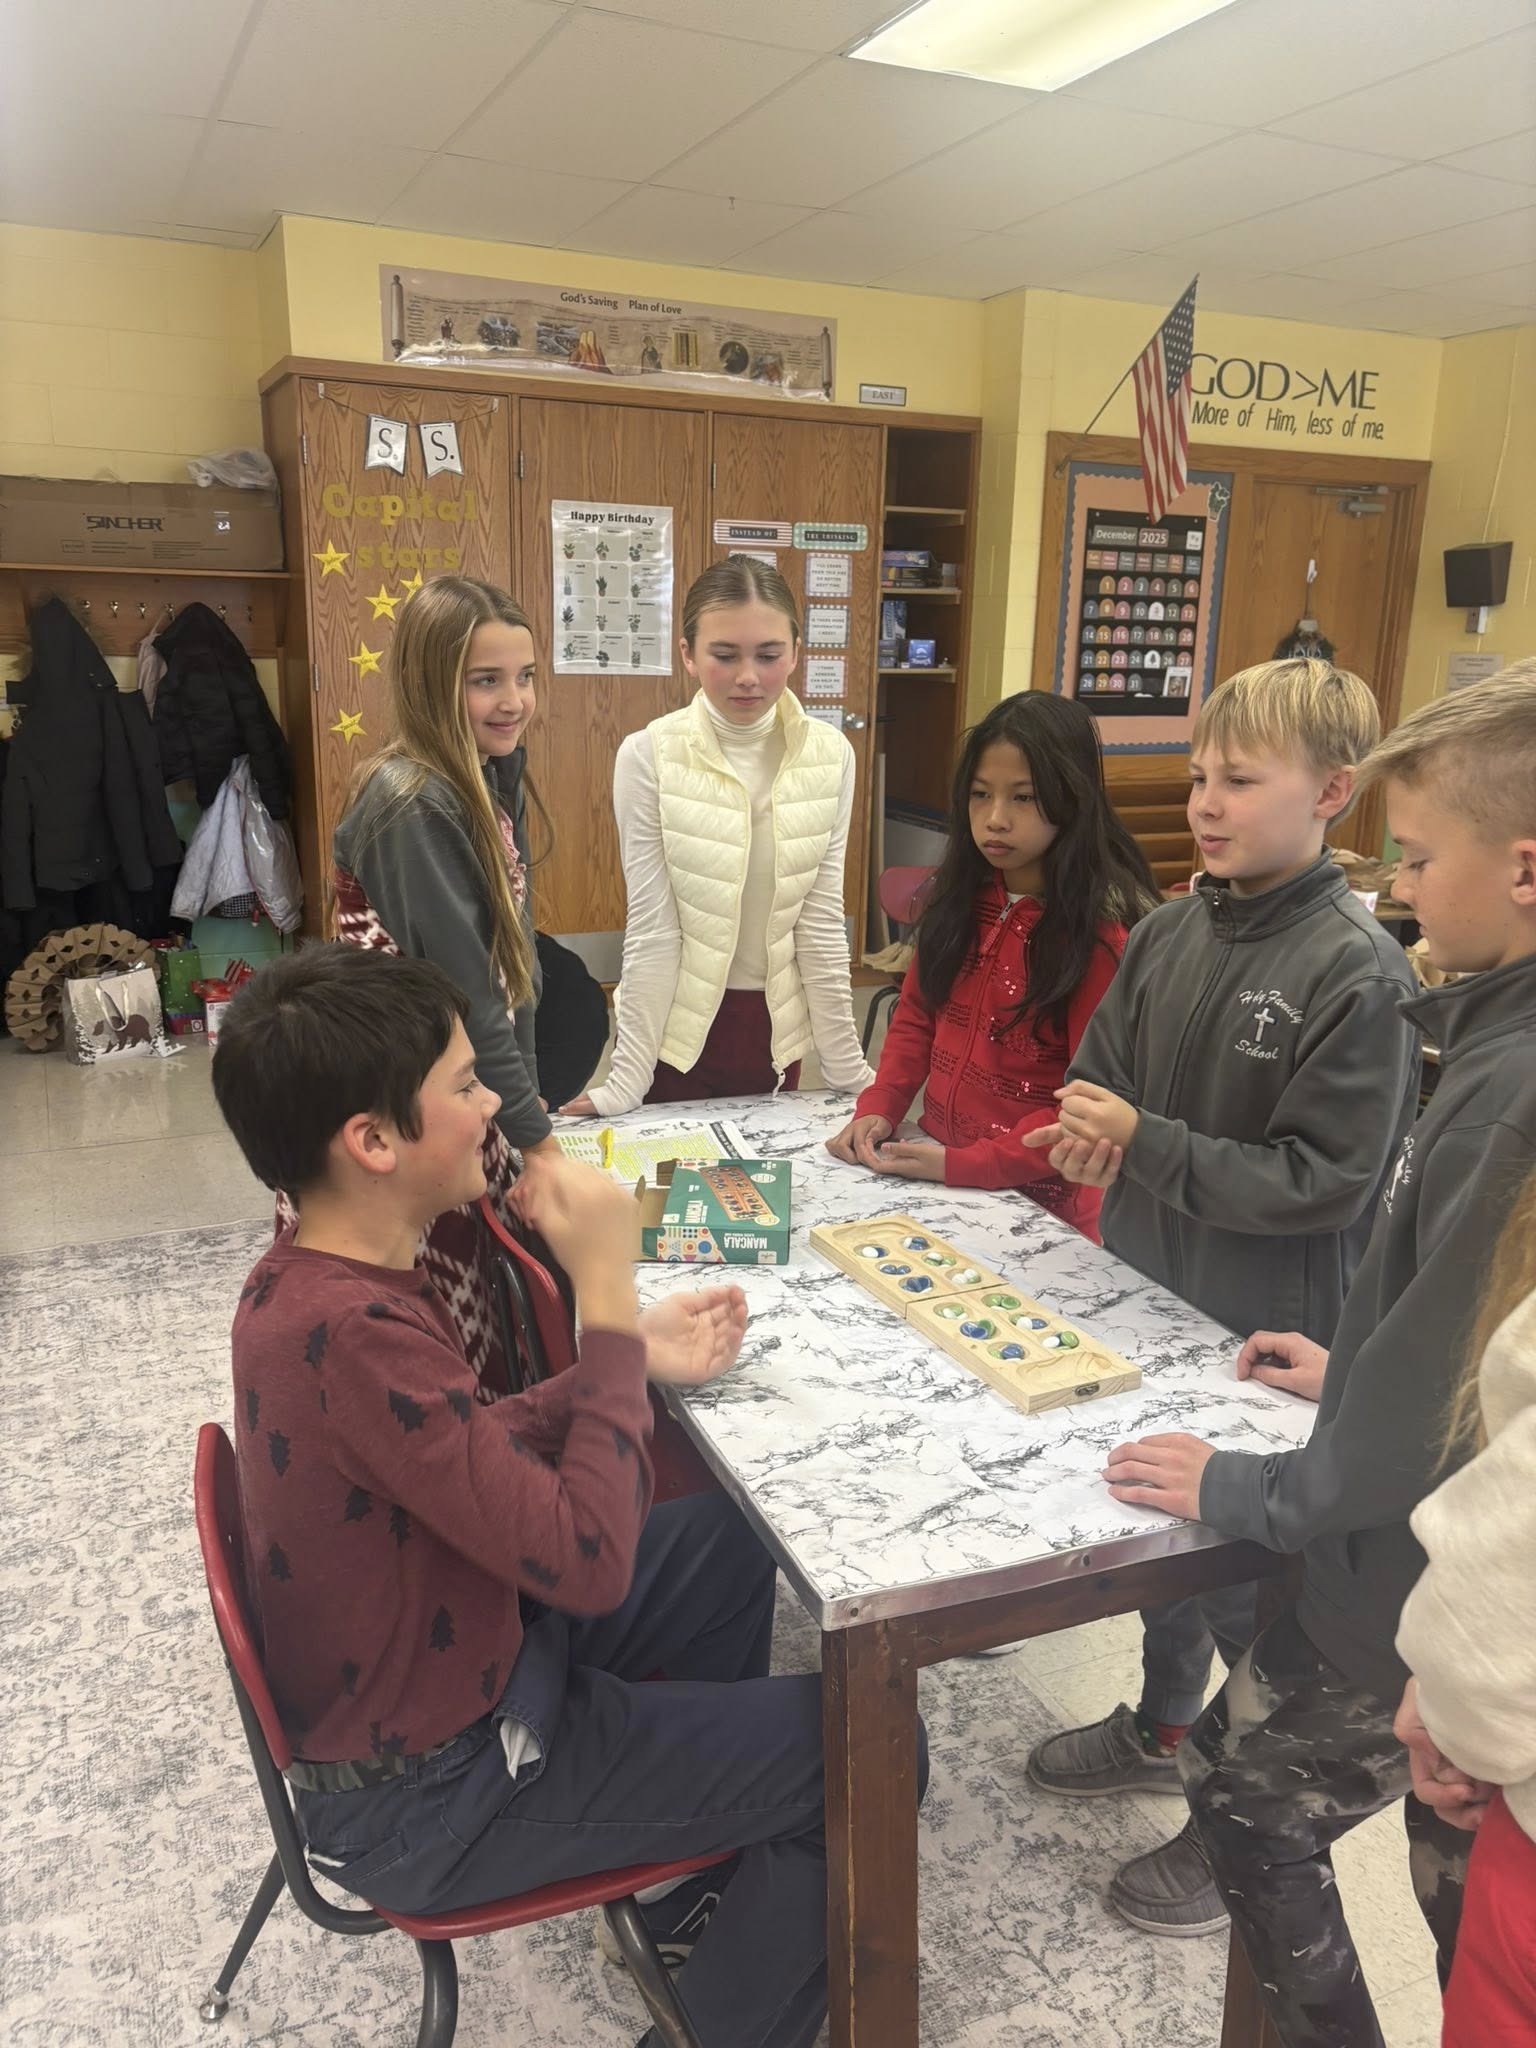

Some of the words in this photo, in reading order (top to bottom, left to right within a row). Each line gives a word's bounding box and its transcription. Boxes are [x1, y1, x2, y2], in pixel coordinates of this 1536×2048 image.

[560, 292, 586, 304] God's
[588, 295, 618, 310] Saving
[628, 299, 648, 311] Plan
[650, 303, 660, 312] of
[661, 304, 682, 314] Love
[872, 390, 895, 400] EAST
[1191, 401, 1229, 426] More
[1237, 402, 1256, 428] of
[1265, 408, 1297, 436] Him,
[1306, 410, 1333, 435] less
[1342, 413, 1358, 438] of
[377, 427, 399, 461] S.
[430, 430, 455, 462] S.
[322, 482, 479, 527] Capital
[570, 510, 606, 524] Happy
[607, 512, 655, 527] Birthday
[1095, 529, 1136, 540] December
[1142, 532, 1167, 544] 2025
[355, 541, 462, 570] stars
[1122, 582, 1128, 591] 2
[1138, 582, 1145, 591] 3
[1154, 583, 1161, 591] 4
[1171, 584, 1178, 593] 5
[1188, 584, 1195, 593] 6
[1088, 605, 1095, 615] 7
[1103, 603, 1110, 614] 8
[1119, 605, 1126, 616] 9
[1135, 608, 1146, 617] 10
[1168, 608, 1177, 618] 12
[1183, 608, 1193, 618] 13
[1085, 630, 1094, 640] 14
[1099, 630, 1109, 641] 15
[1116, 630, 1126, 640] 16
[1133, 630, 1142, 640] 17
[1150, 631, 1159, 641] 18
[1164, 631, 1174, 642] 19
[1181, 632, 1192, 643] 20
[1084, 655, 1093, 665] 21
[1097, 655, 1107, 665] 22
[1114, 654, 1125, 665] 23
[1131, 655, 1140, 665] 24
[1163, 656, 1173, 666] 26
[1180, 657, 1190, 666] 27
[1083, 678, 1092, 688] 28
[1098, 678, 1107, 688] 29
[1112, 678, 1122, 688] 30
[1130, 679, 1139, 689] 31
[1264, 990, 1305, 1024] Family
[1234, 1039, 1279, 1059] School
[723, 1236, 768, 1249] MANCALA
